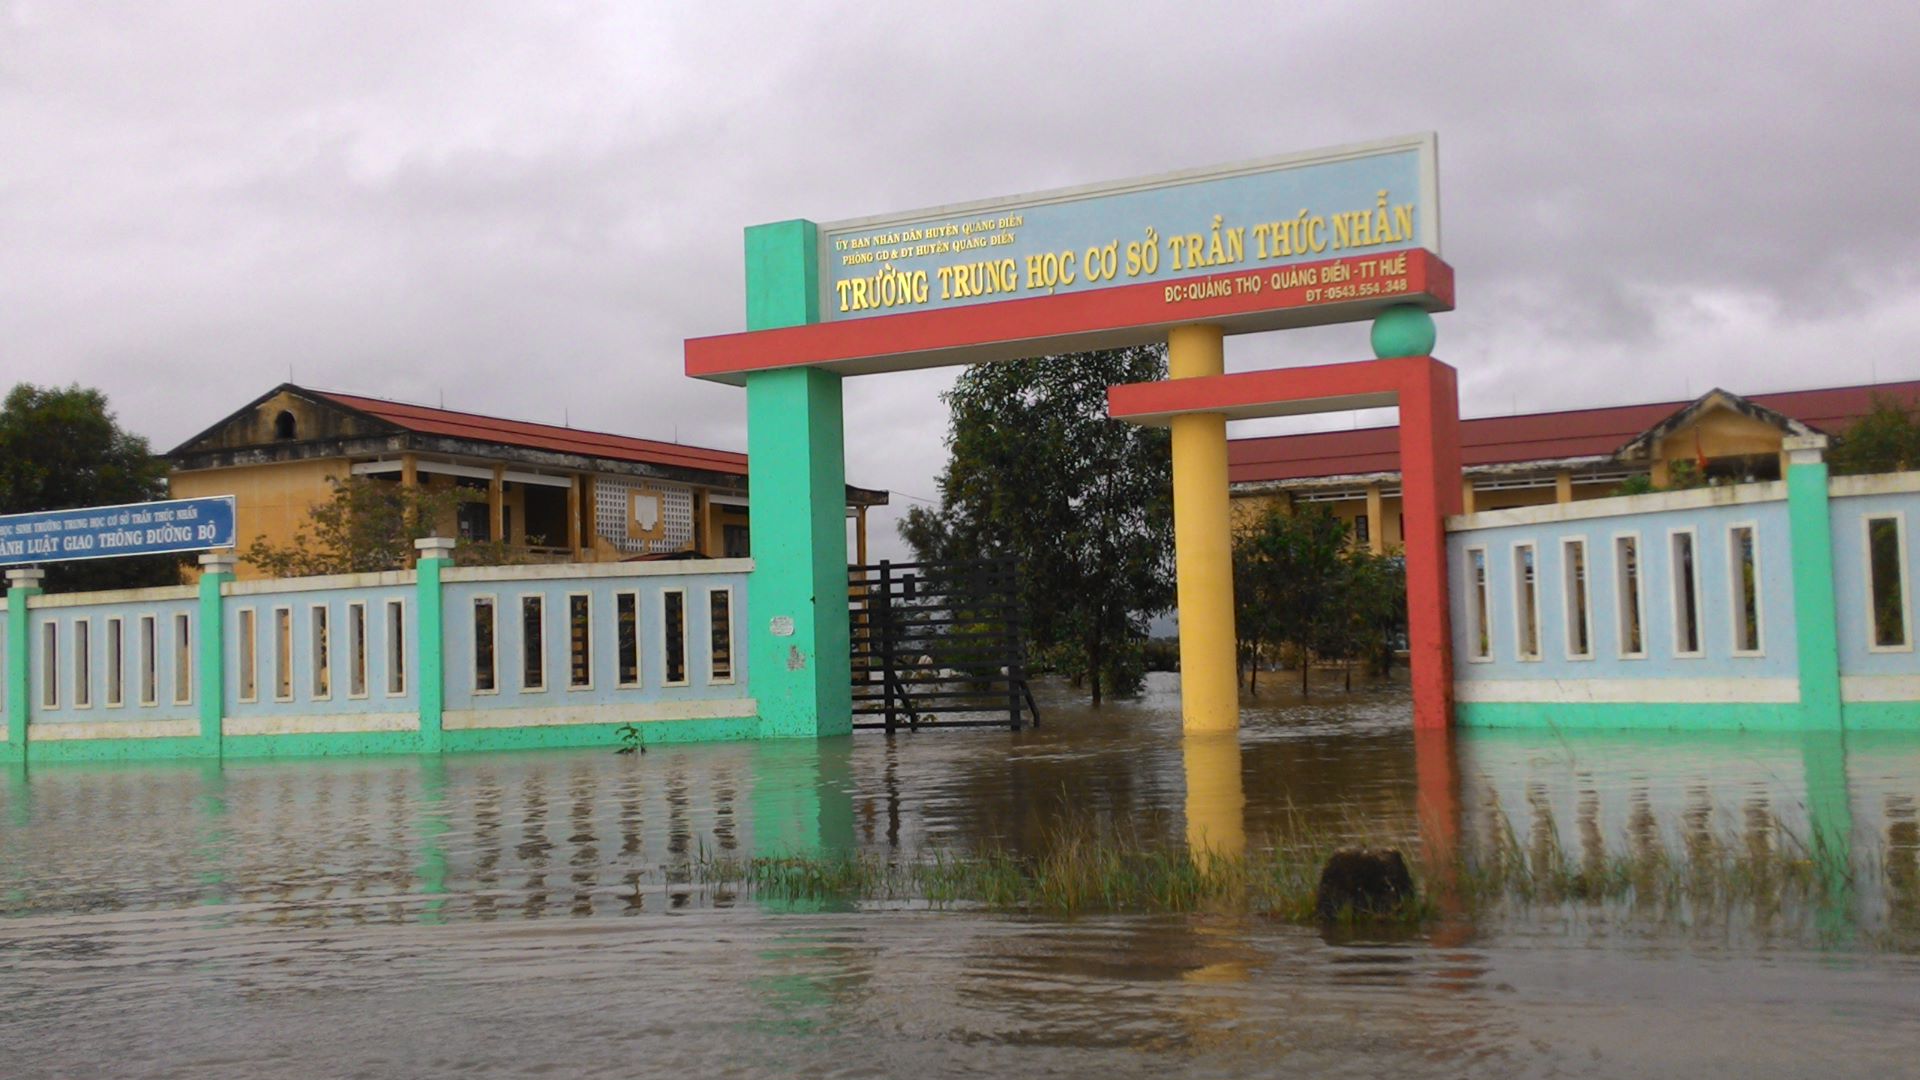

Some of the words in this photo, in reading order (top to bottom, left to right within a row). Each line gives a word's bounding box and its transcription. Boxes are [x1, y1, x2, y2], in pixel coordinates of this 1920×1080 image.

[837, 263, 929, 312] TRƯỜNG
[938, 258, 1018, 300] TRUNG
[1025, 250, 1075, 294] HỌC
[1084, 239, 1118, 283] CƠ
[1126, 225, 1159, 277] SỞ
[1168, 214, 1245, 271] TRẦN
[1253, 208, 1328, 260] THÚC
[851, 237, 871, 249] BAN
[876, 250, 889, 261] GD
[890, 248, 898, 260] &
[1236, 275, 1262, 294] THỌ
[1271, 265, 1317, 290] QUẢNG
[1379, 251, 1407, 277] HUẾ
[27, 534, 60, 556] LUẬT
[63, 533, 94, 551] GIAO
[98, 528, 143, 548] THÔNG
[146, 522, 192, 544] ĐƯỜNG
[198, 520, 216, 544] BỘ
